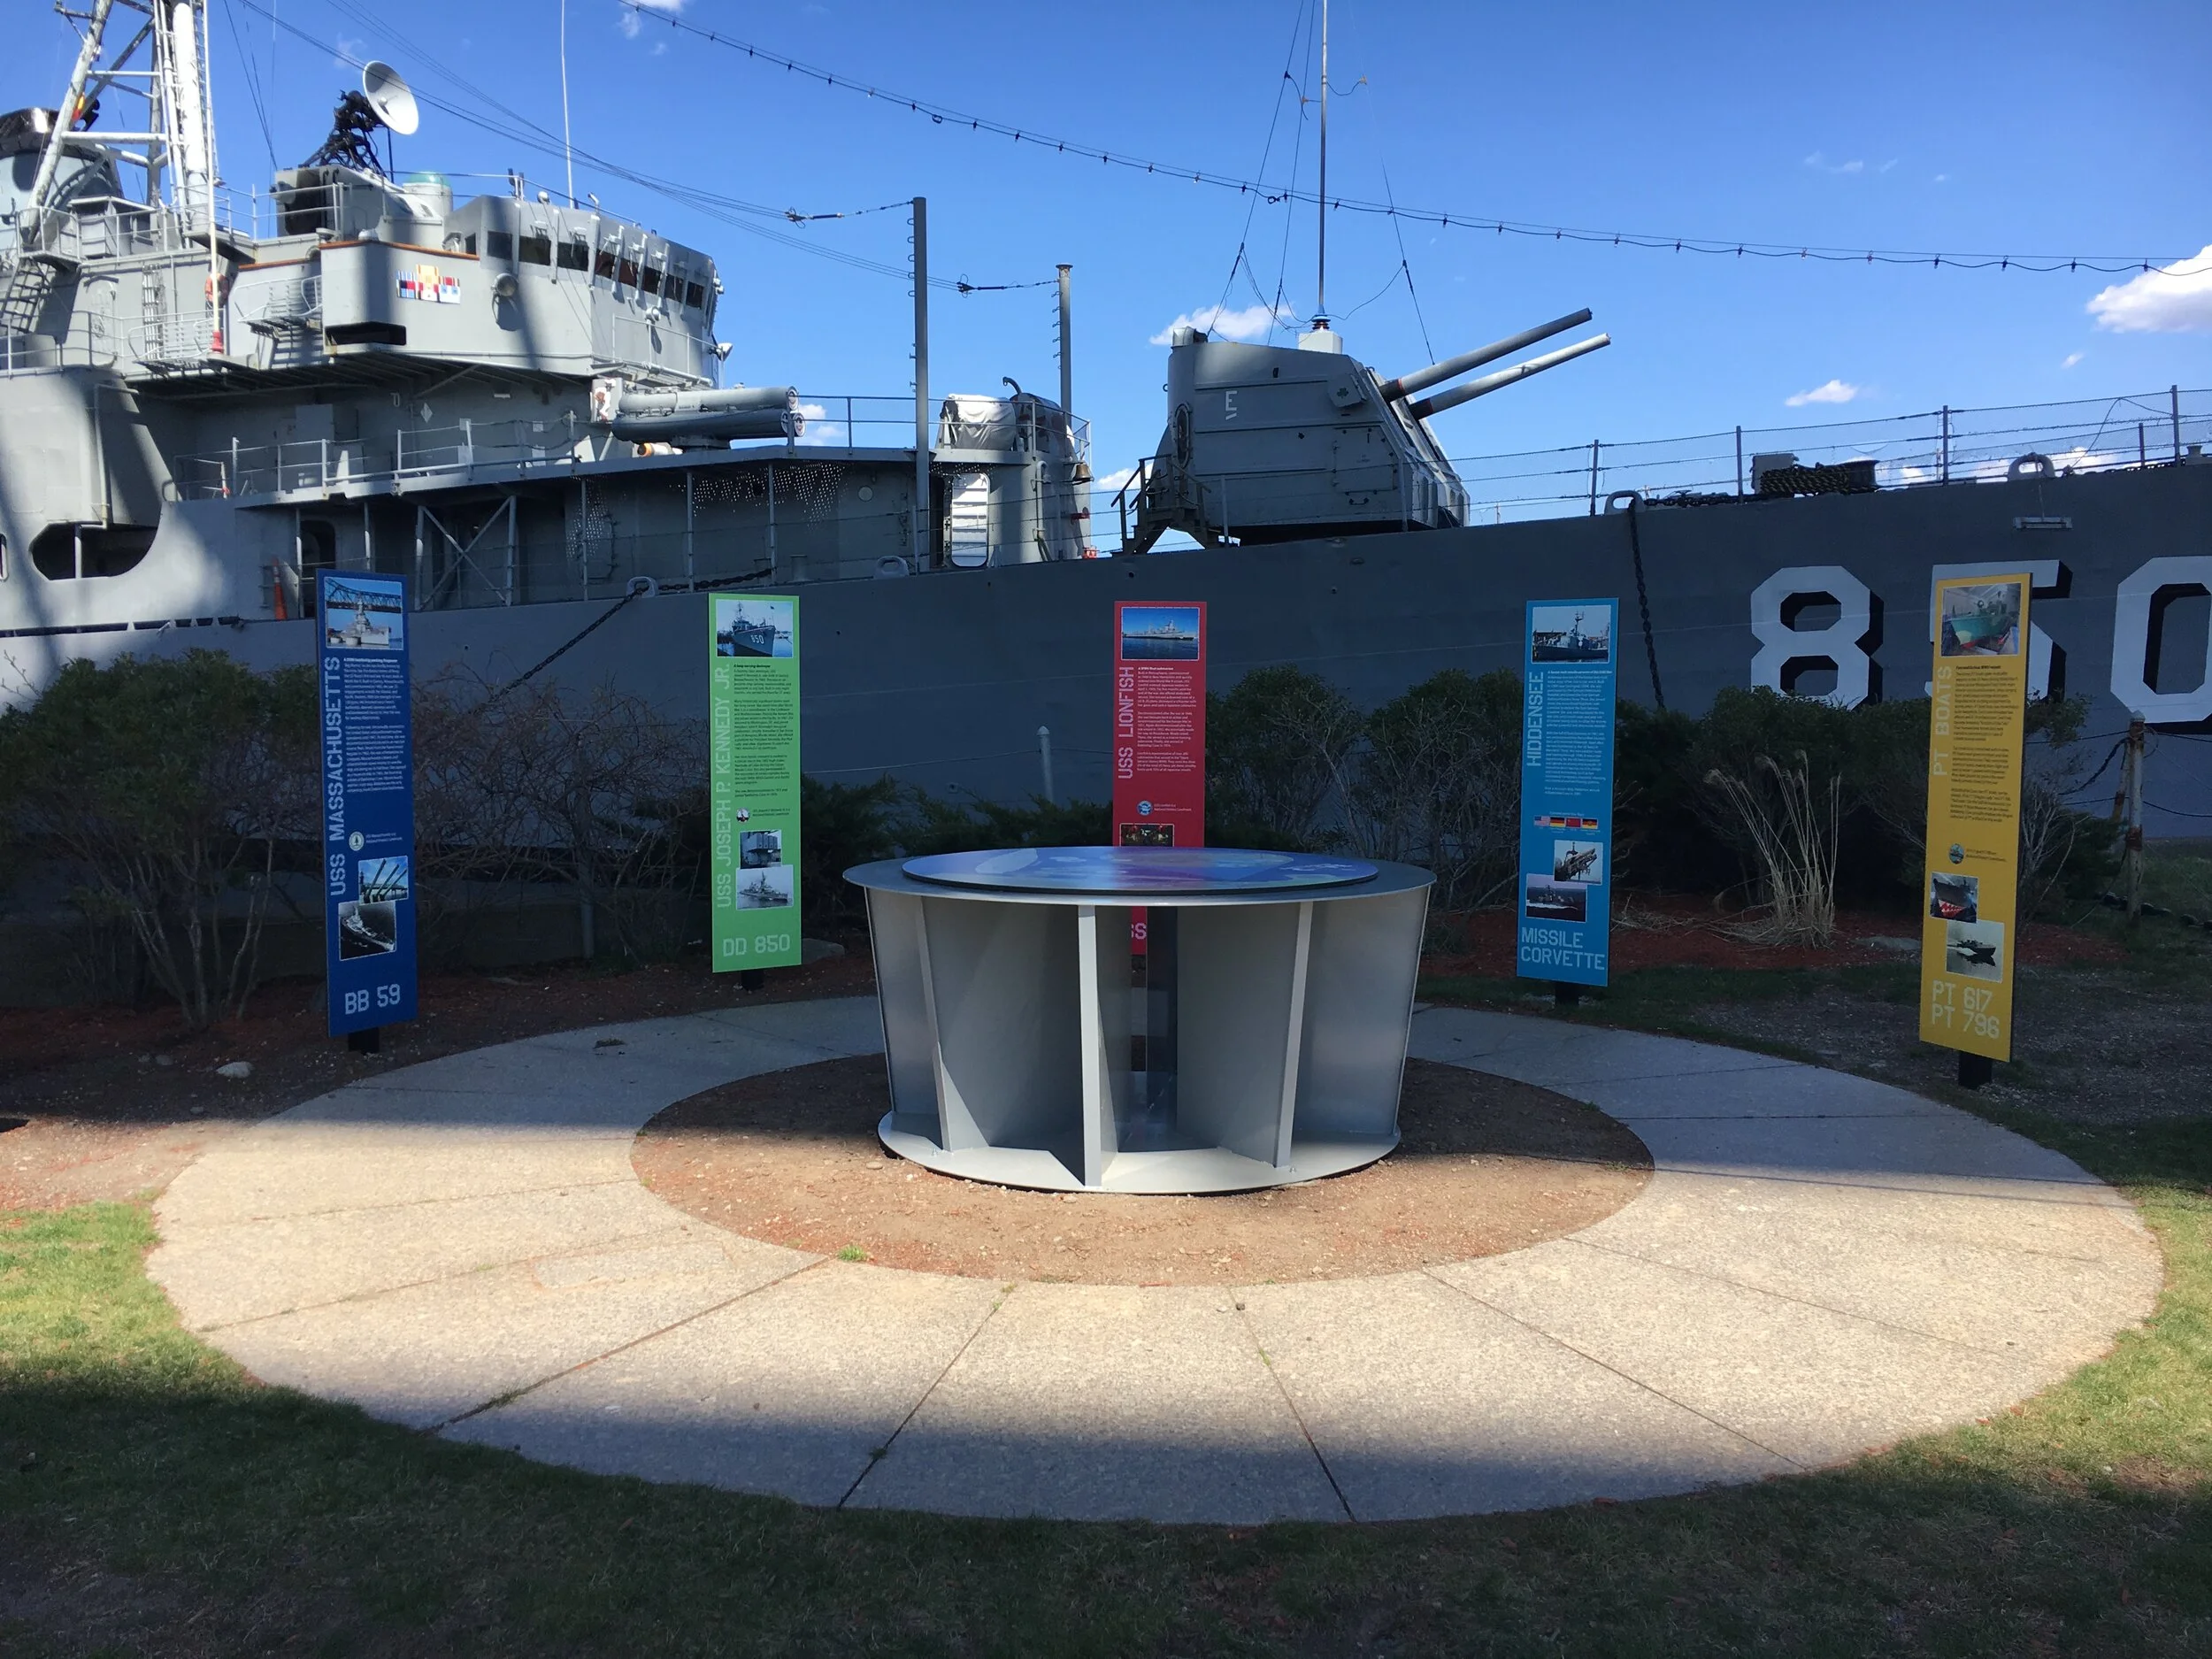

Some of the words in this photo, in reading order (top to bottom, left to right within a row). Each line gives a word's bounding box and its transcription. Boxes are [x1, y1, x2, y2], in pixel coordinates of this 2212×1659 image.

[715, 664, 731, 690] JR.
[1118, 666, 1134, 738] LIONFISH
[1935, 664, 1952, 736] BOATS
[715, 697, 731, 774] KENNEDY
[1526, 672, 1544, 767] HIDDENSEE
[325, 657, 345, 841] MASSACHUSETTS
[1118, 747, 1133, 780] USS
[1932, 749, 1949, 776] PT
[715, 781, 731, 793] P.
[716, 799, 732, 867] JOSEPH
[330, 853, 346, 896] USS
[717, 873, 732, 908] USS
[723, 937, 748, 957] DD
[754, 933, 790, 954] 850
[1521, 926, 1584, 949] MISSILE
[1521, 946, 1605, 971] CORVETTE
[344, 989, 370, 1015] BB
[376, 983, 401, 1009] 59
[1932, 979, 1956, 1005] PT
[1963, 986, 1993, 1013] 617
[1932, 1002, 1955, 1028] PT
[1963, 1010, 2001, 1040] 796
